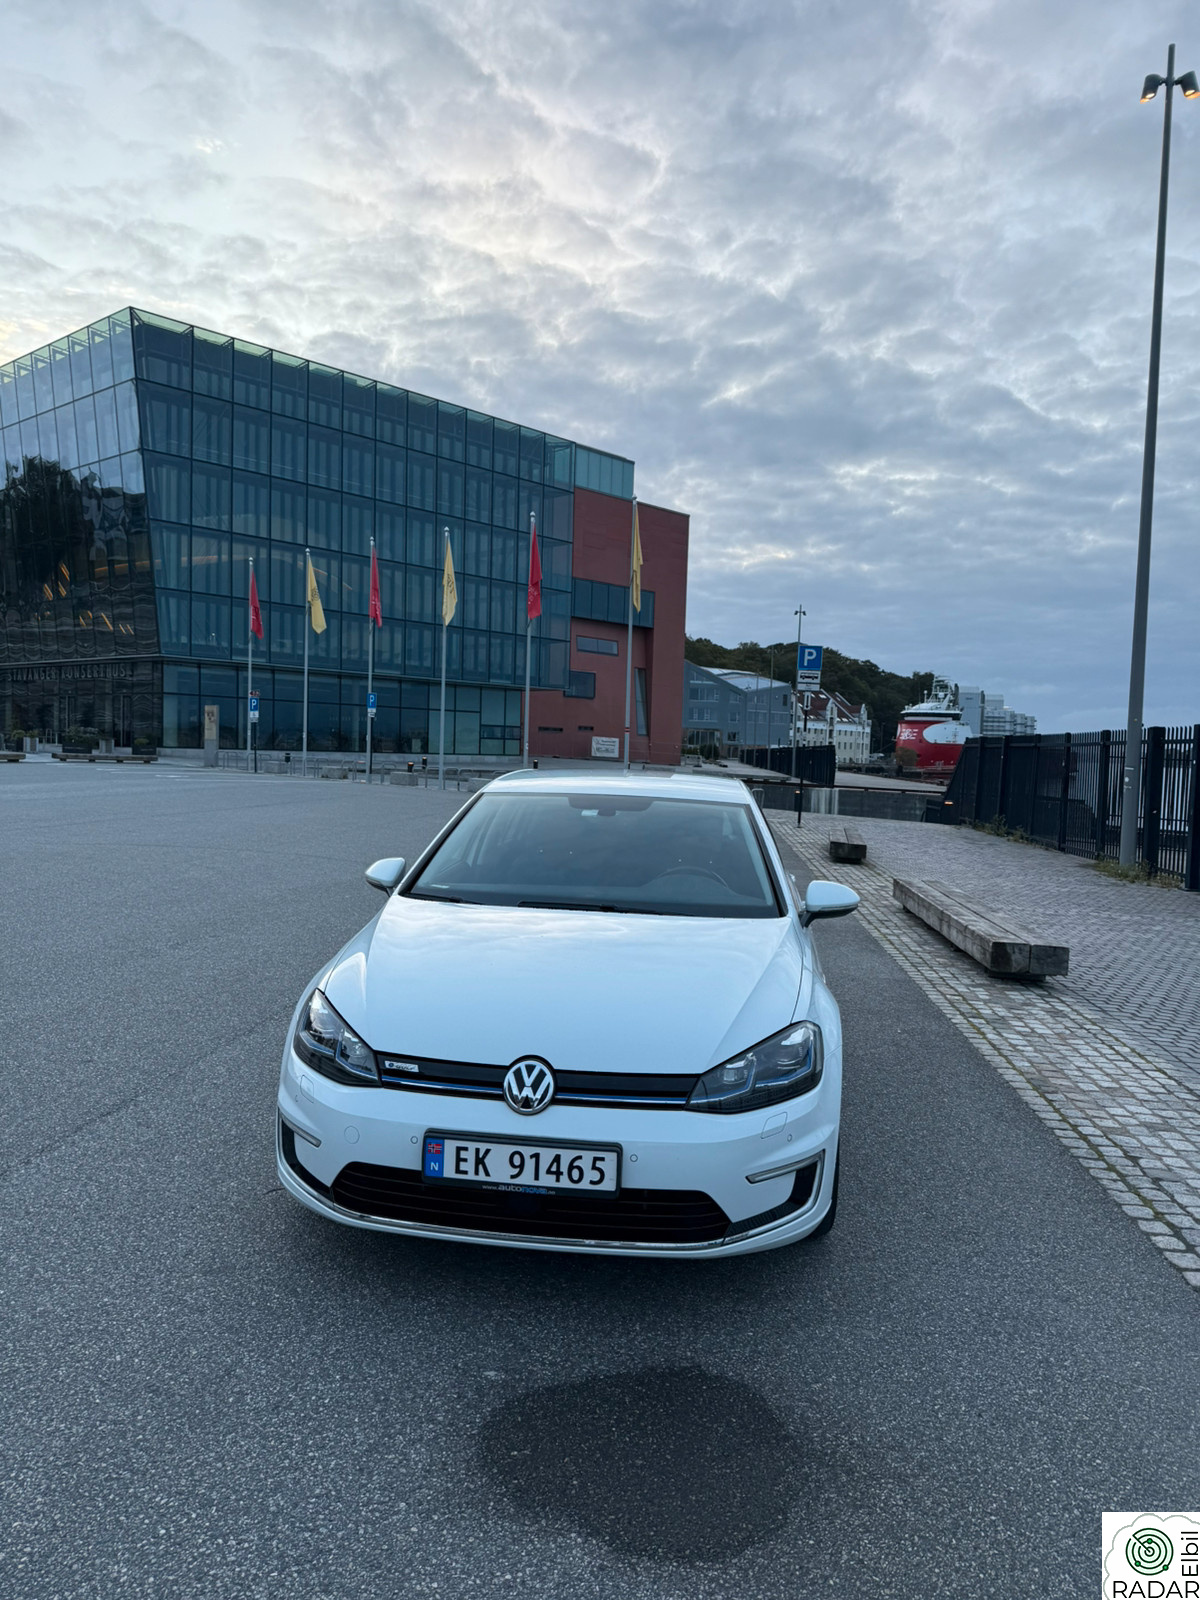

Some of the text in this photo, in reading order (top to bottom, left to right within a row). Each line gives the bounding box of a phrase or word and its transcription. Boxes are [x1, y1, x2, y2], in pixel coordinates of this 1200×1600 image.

[804, 649, 817, 666] P
[7, 664, 126, 681] STAVANGER KONSERTHUS
[430, 1162, 438, 1171] N
[454, 1146, 606, 1185] EK 91465
